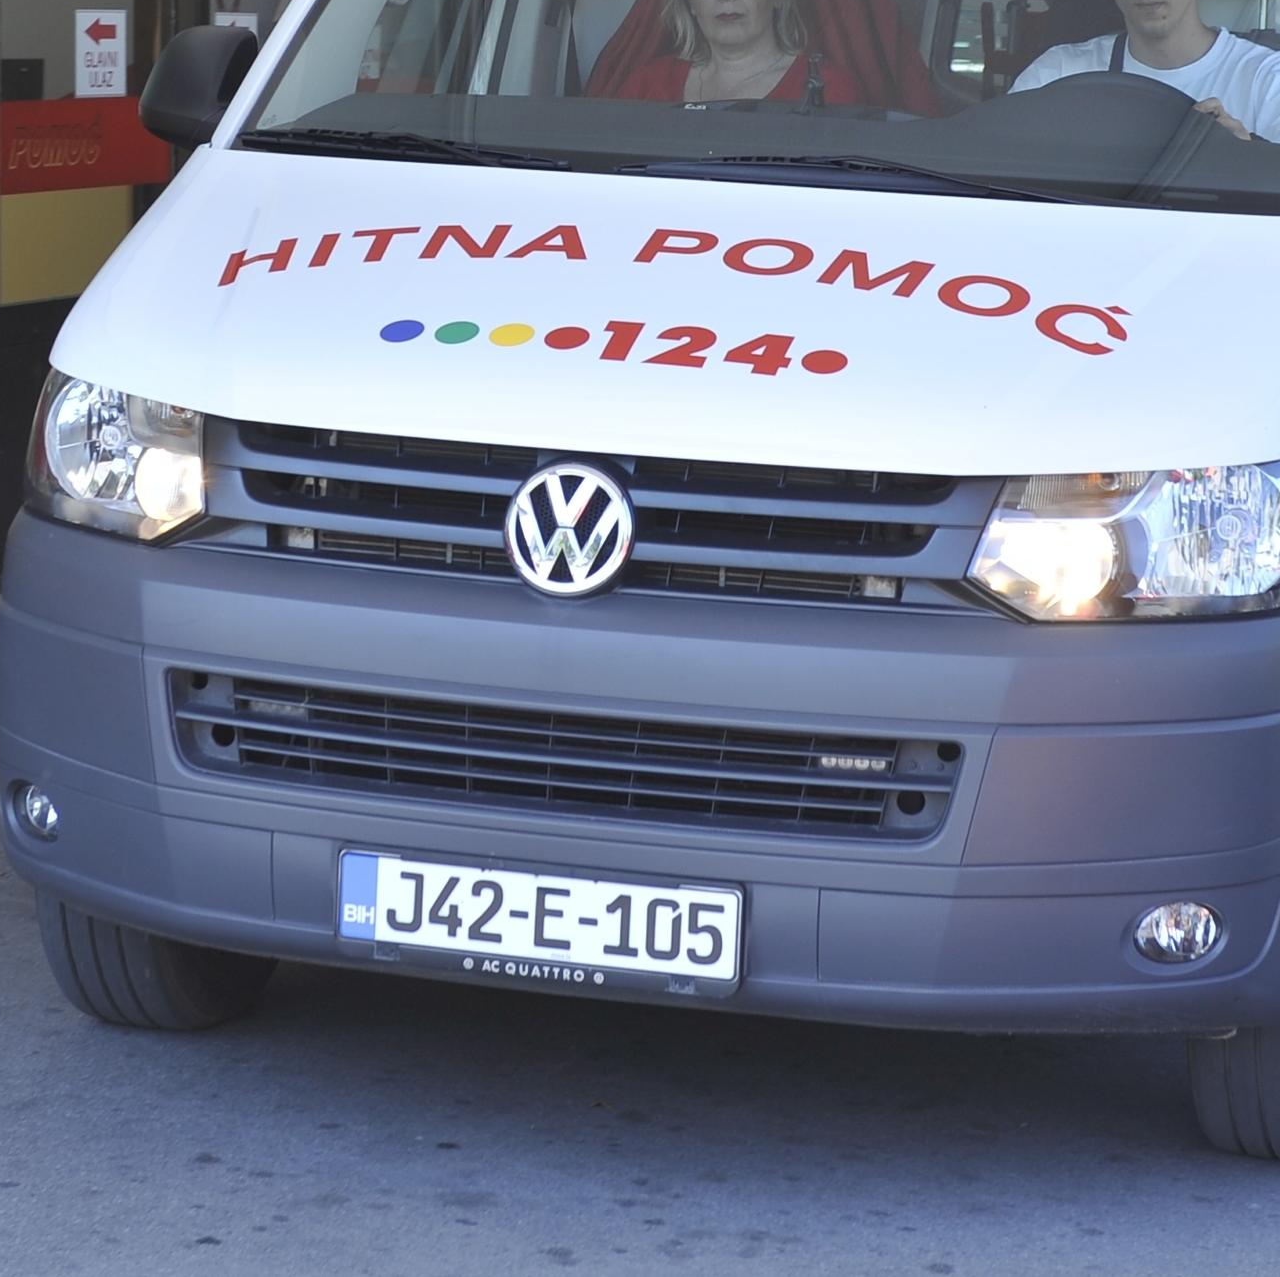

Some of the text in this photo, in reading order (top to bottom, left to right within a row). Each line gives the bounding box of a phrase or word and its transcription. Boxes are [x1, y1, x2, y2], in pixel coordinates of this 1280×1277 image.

[88, 70, 115, 89] ULAZ
[216, 224, 1134, 356] HITNA POMOĆ
[598, 319, 796, 376] 124
[343, 902, 376, 926] BIH
[386, 870, 726, 966] J42-E-105
[481, 958, 586, 984] AC QUATTRO
